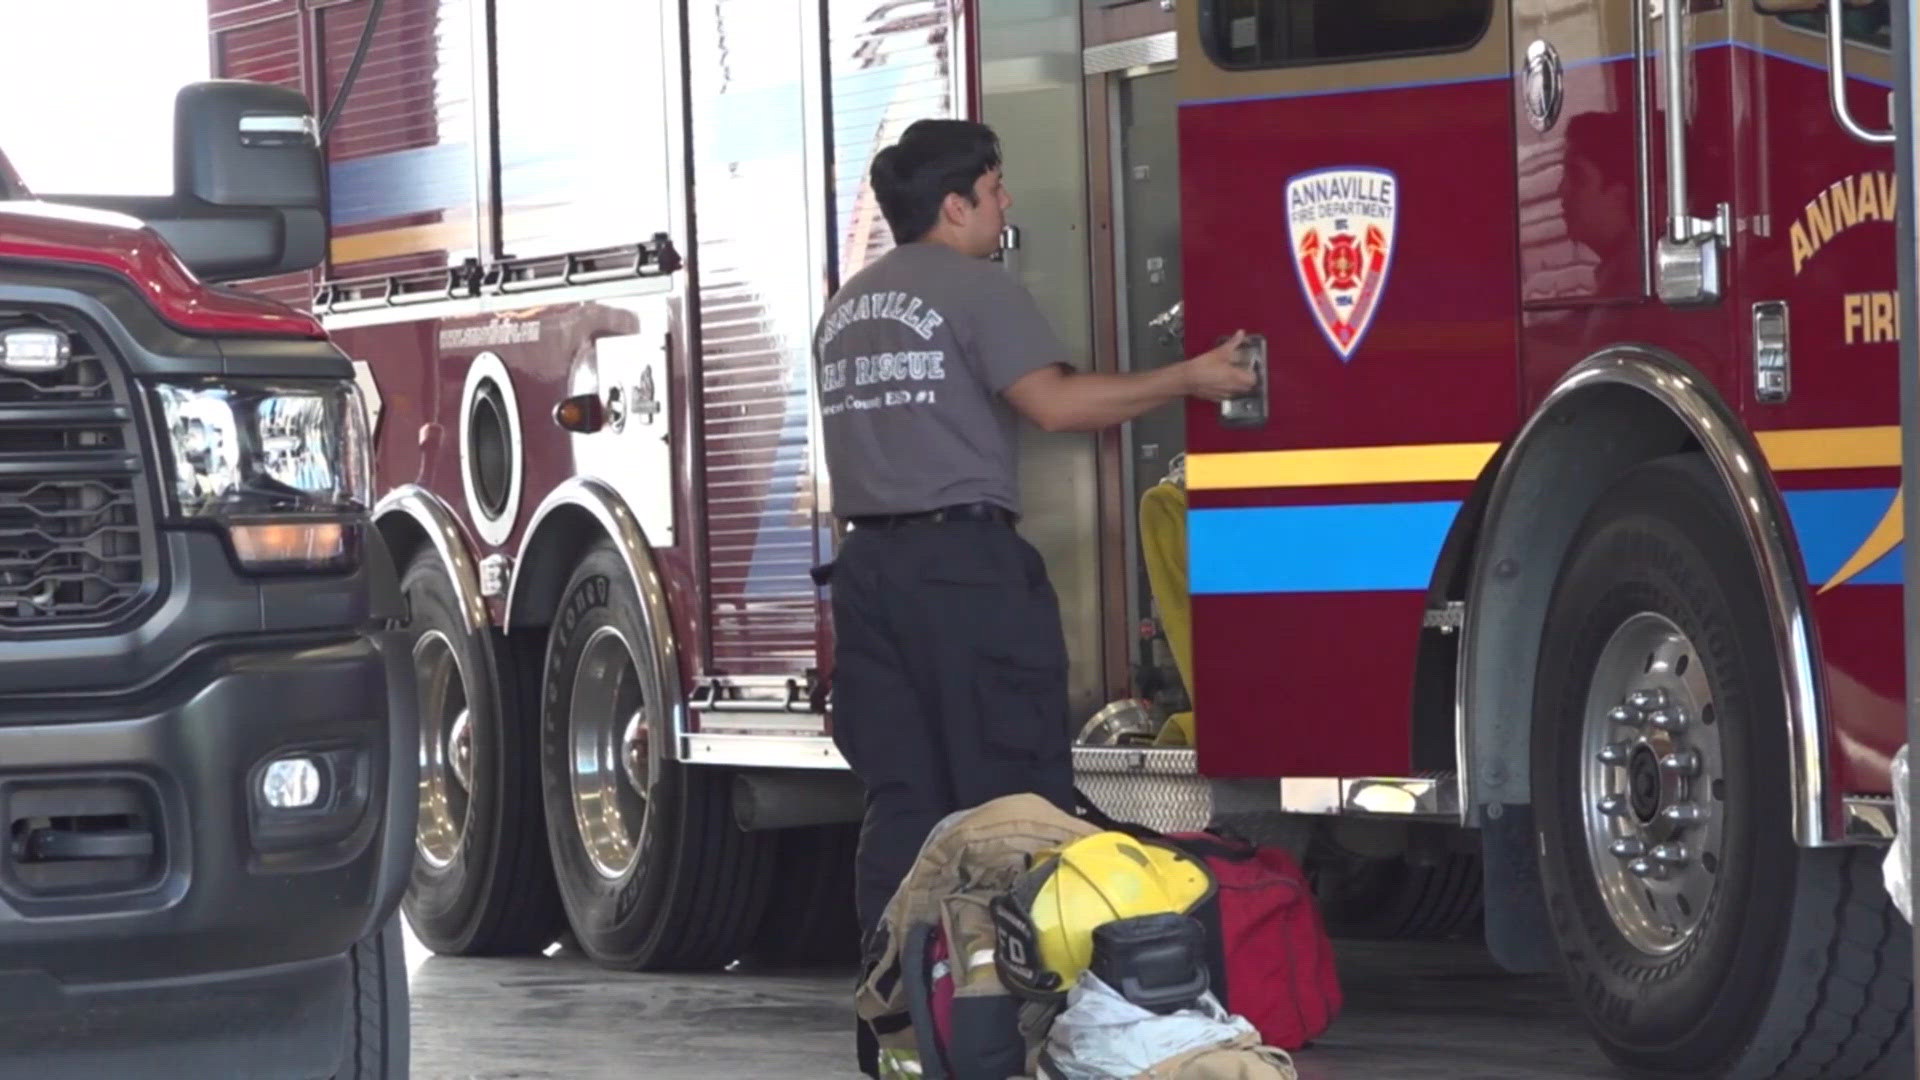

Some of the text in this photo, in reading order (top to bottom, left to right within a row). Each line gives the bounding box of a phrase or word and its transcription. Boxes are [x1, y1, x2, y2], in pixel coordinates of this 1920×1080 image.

[1291, 176, 1392, 209] ANNAVILLE
[1291, 200, 1392, 222] FIRE DEPARTMENT
[855, 350, 945, 386] RESCUE
[885, 390, 911, 406] ESD
[915, 390, 936, 404] #1
